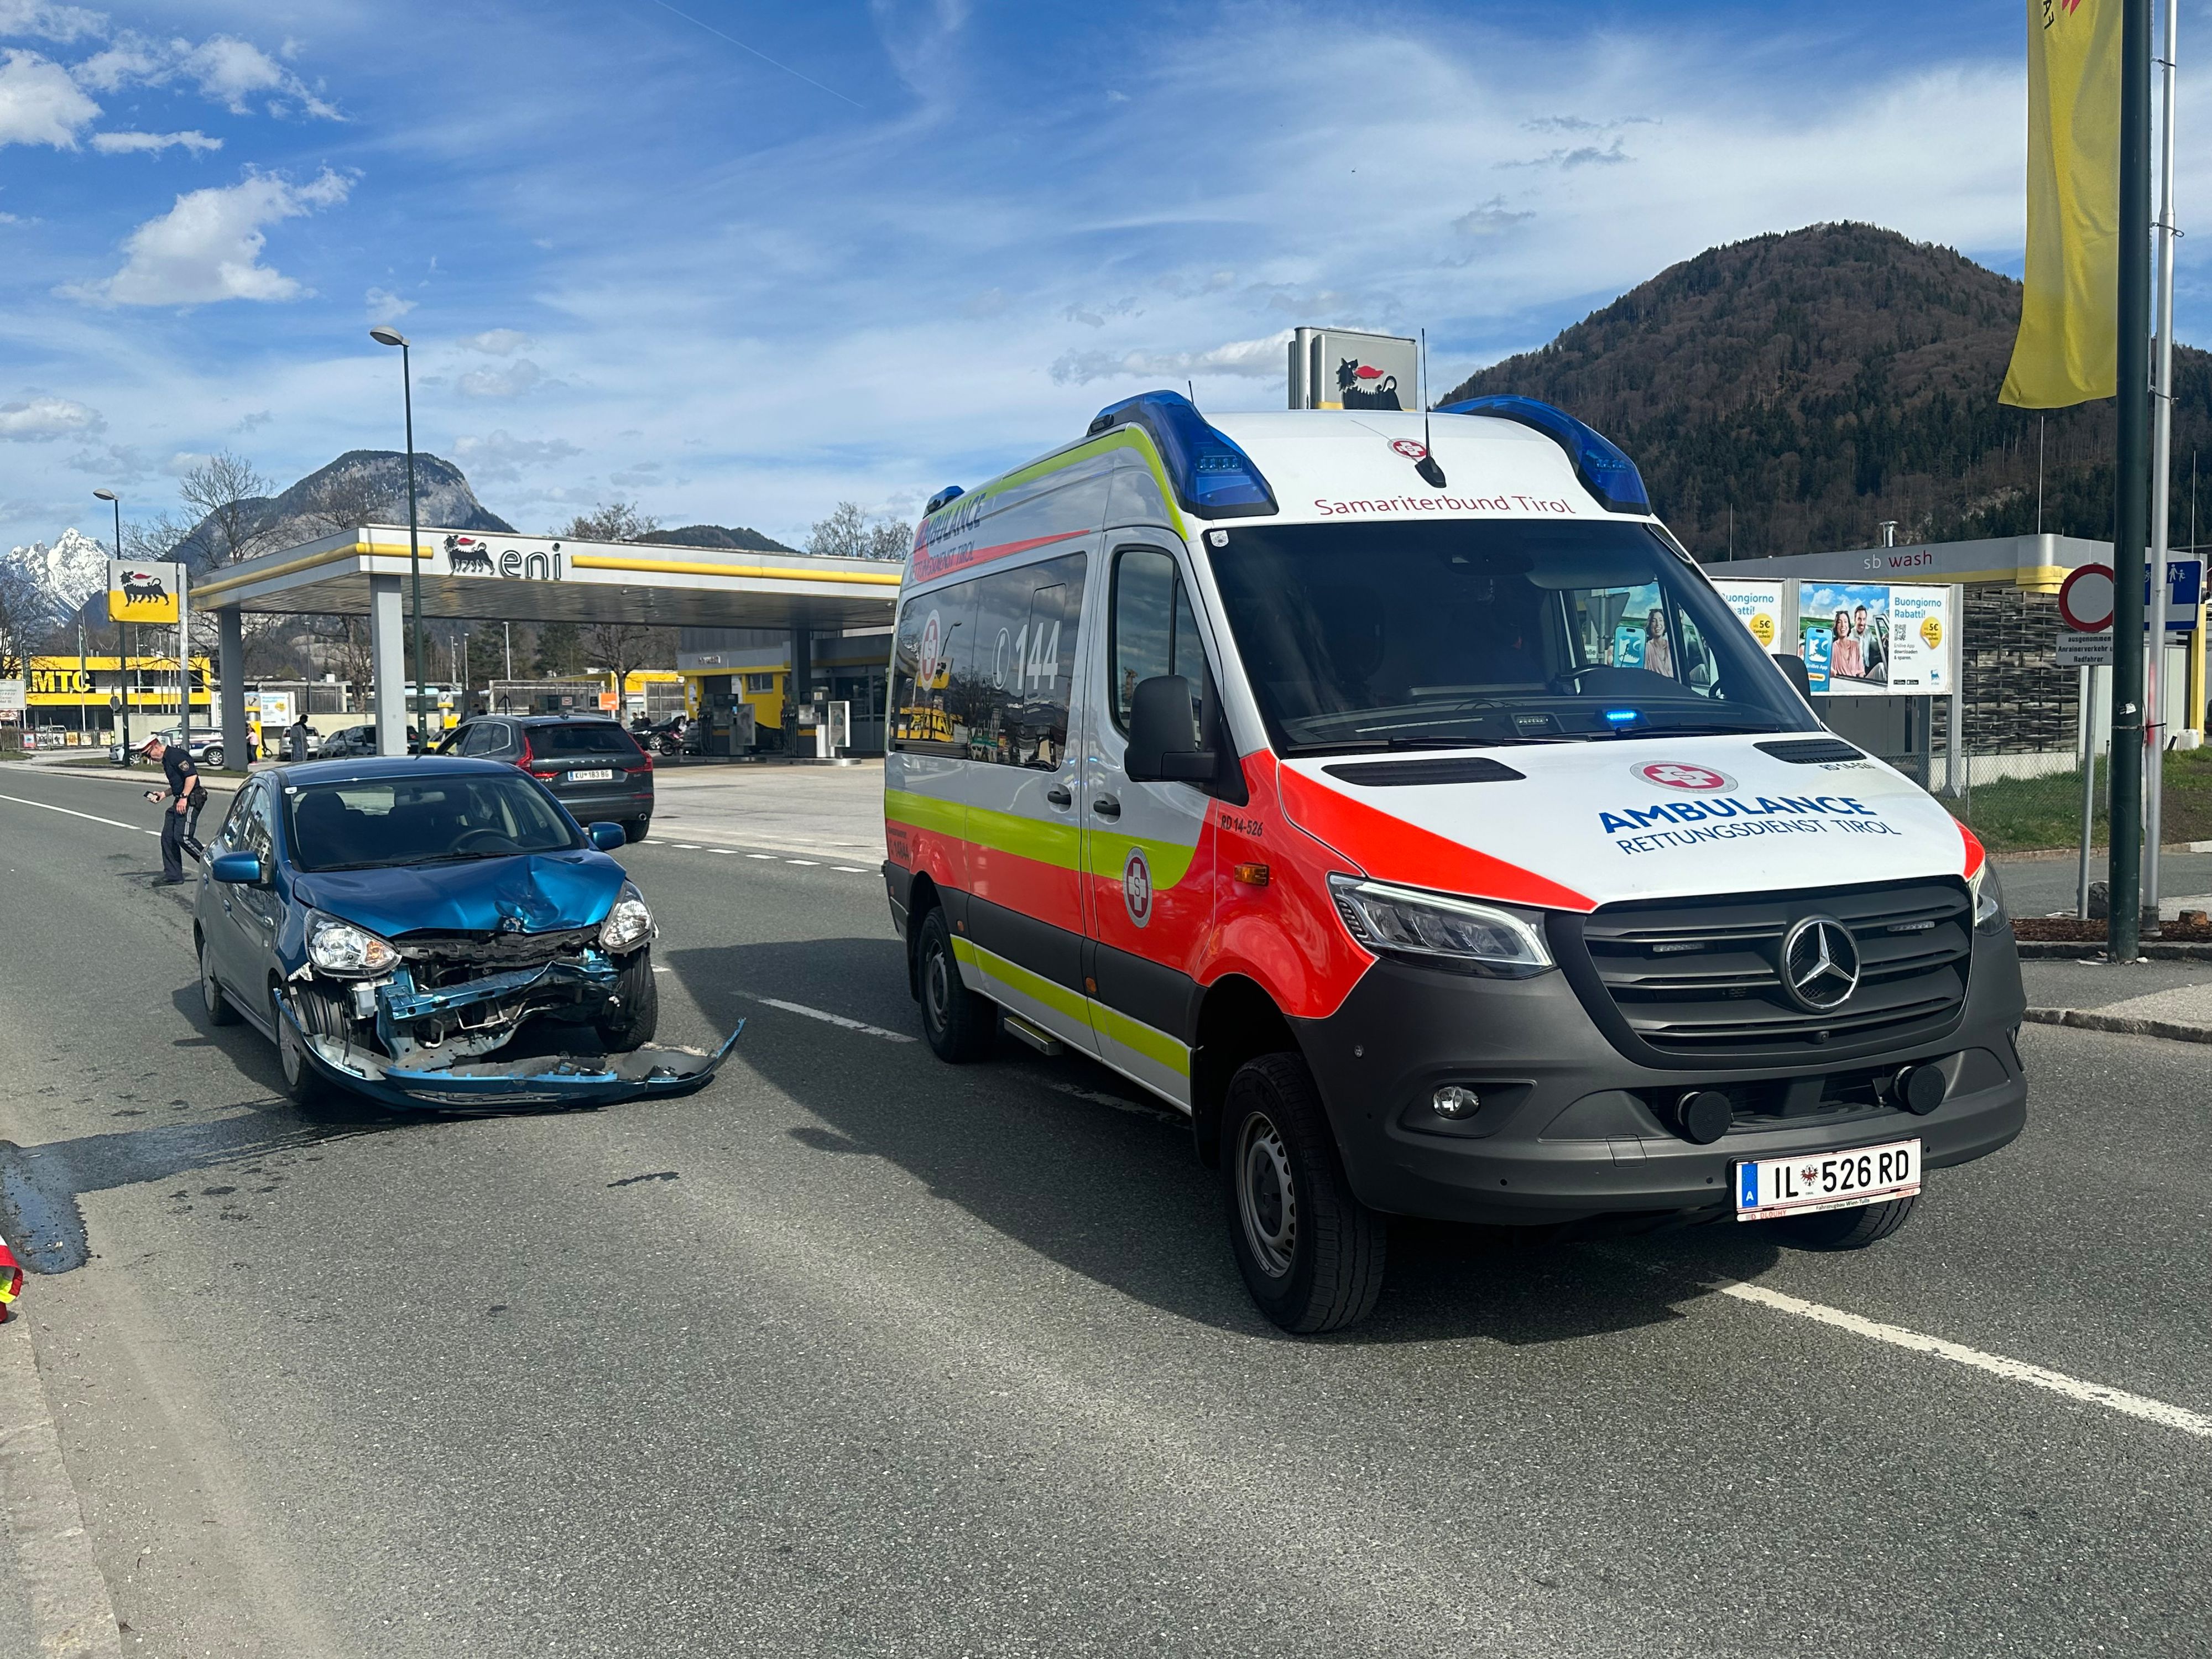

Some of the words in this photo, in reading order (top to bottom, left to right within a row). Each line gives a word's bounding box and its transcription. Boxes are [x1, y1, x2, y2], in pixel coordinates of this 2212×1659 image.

[1314, 495, 1511, 515] Samariterbund
[1511, 495, 1576, 514] Tirol
[499, 542, 562, 581] eni
[1864, 554, 1881, 570] sb
[1888, 550, 1932, 568] wash
[1722, 592, 1774, 604] uongiorno
[1895, 597, 1942, 608] Buongiorno
[1759, 620, 1771, 628] 5€
[1895, 609, 1926, 619] Rabatti!
[1015, 620, 1061, 690] 144
[28, 671, 91, 692] MTC
[575, 770, 584, 779] KU
[1598, 796, 1879, 834] AMBULANCE
[1220, 815, 1233, 830] RD
[1234, 817, 1264, 837] 14-526
[1616, 820, 1829, 855] RETTUNGSDIENST
[1830, 820, 1902, 836] TIROL
[1775, 1166, 1799, 1199] IL
[1822, 1156, 1871, 1192] 526
[1879, 1150, 1908, 1185] RD
[1746, 1191, 1755, 1201] A
[1760, 1209, 1787, 1219] DLOUHY
